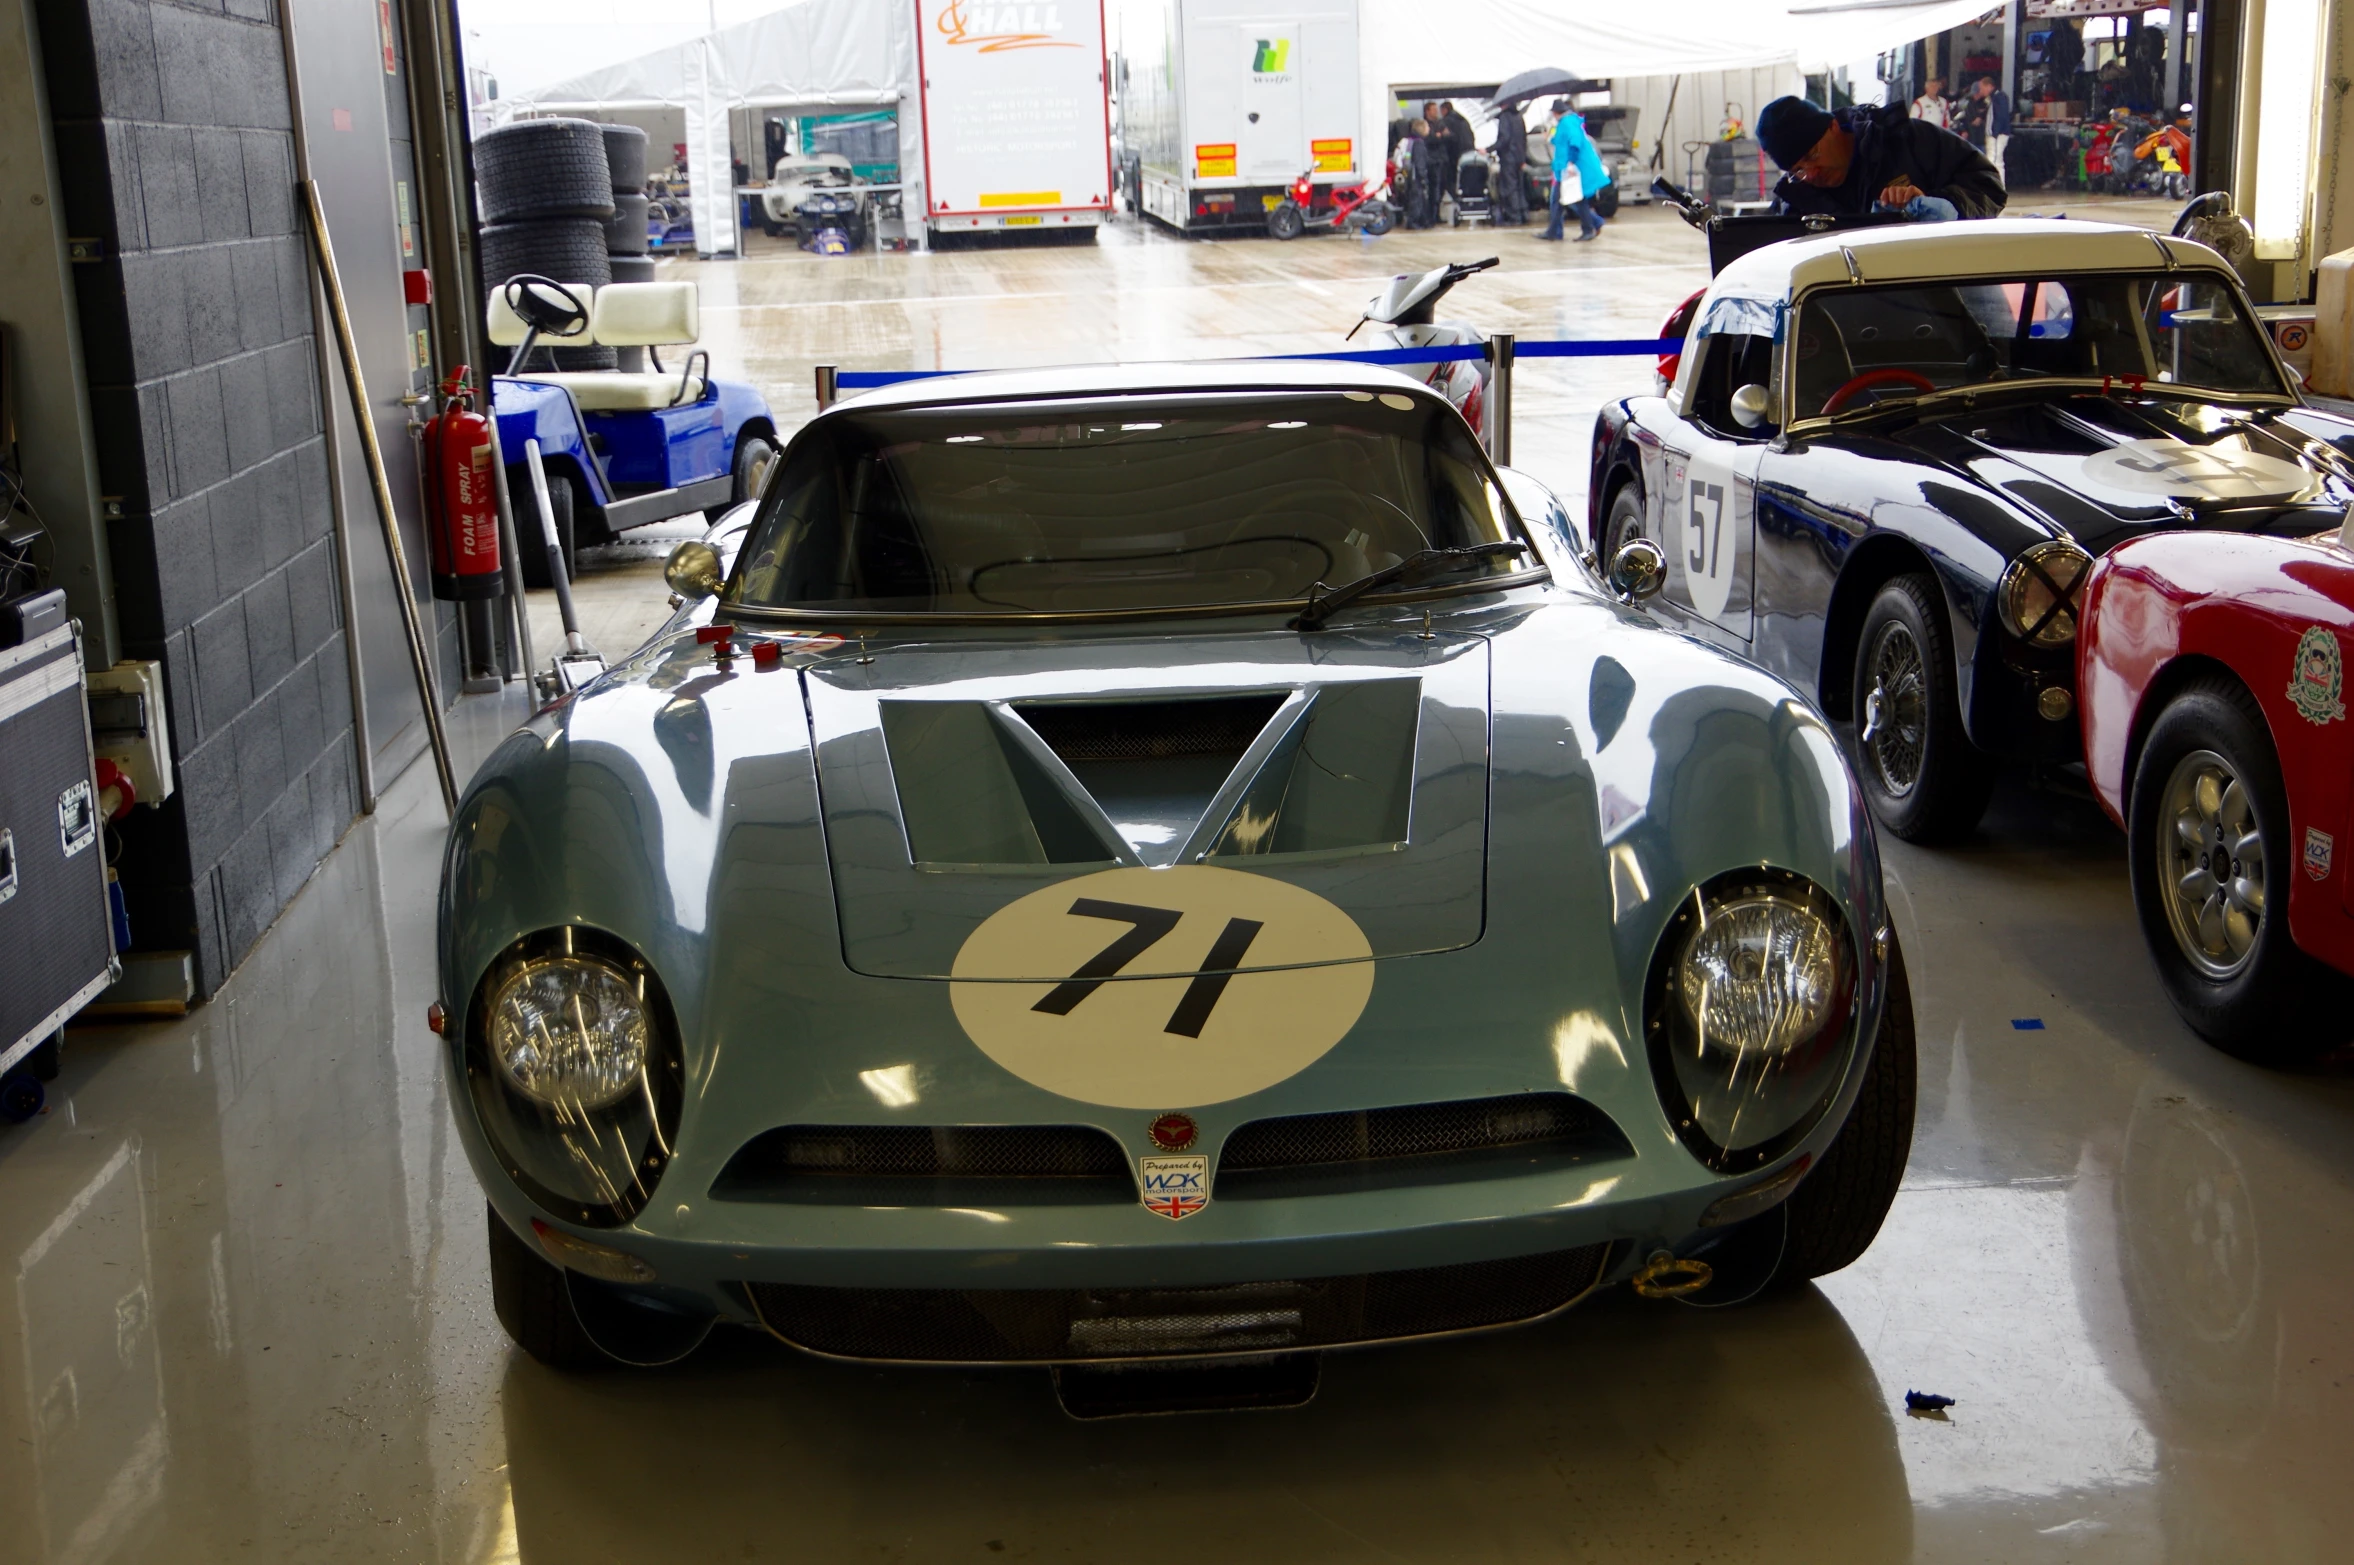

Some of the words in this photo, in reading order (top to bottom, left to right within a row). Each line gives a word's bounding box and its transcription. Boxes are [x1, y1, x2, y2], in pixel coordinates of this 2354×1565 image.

[970, 4, 1063, 33] HALL
[1008, 139, 1078, 152] MOTORSPORT
[457, 462, 472, 506] SPRAY
[461, 515, 476, 557] FOAM
[1689, 479, 1724, 579] 57
[2306, 841, 2330, 860] WDK
[1031, 897, 1265, 1039] 71
[1145, 1161, 1190, 1172] Prepared
[1192, 1160, 1204, 1171] by
[1144, 1173, 1203, 1189] WDK
